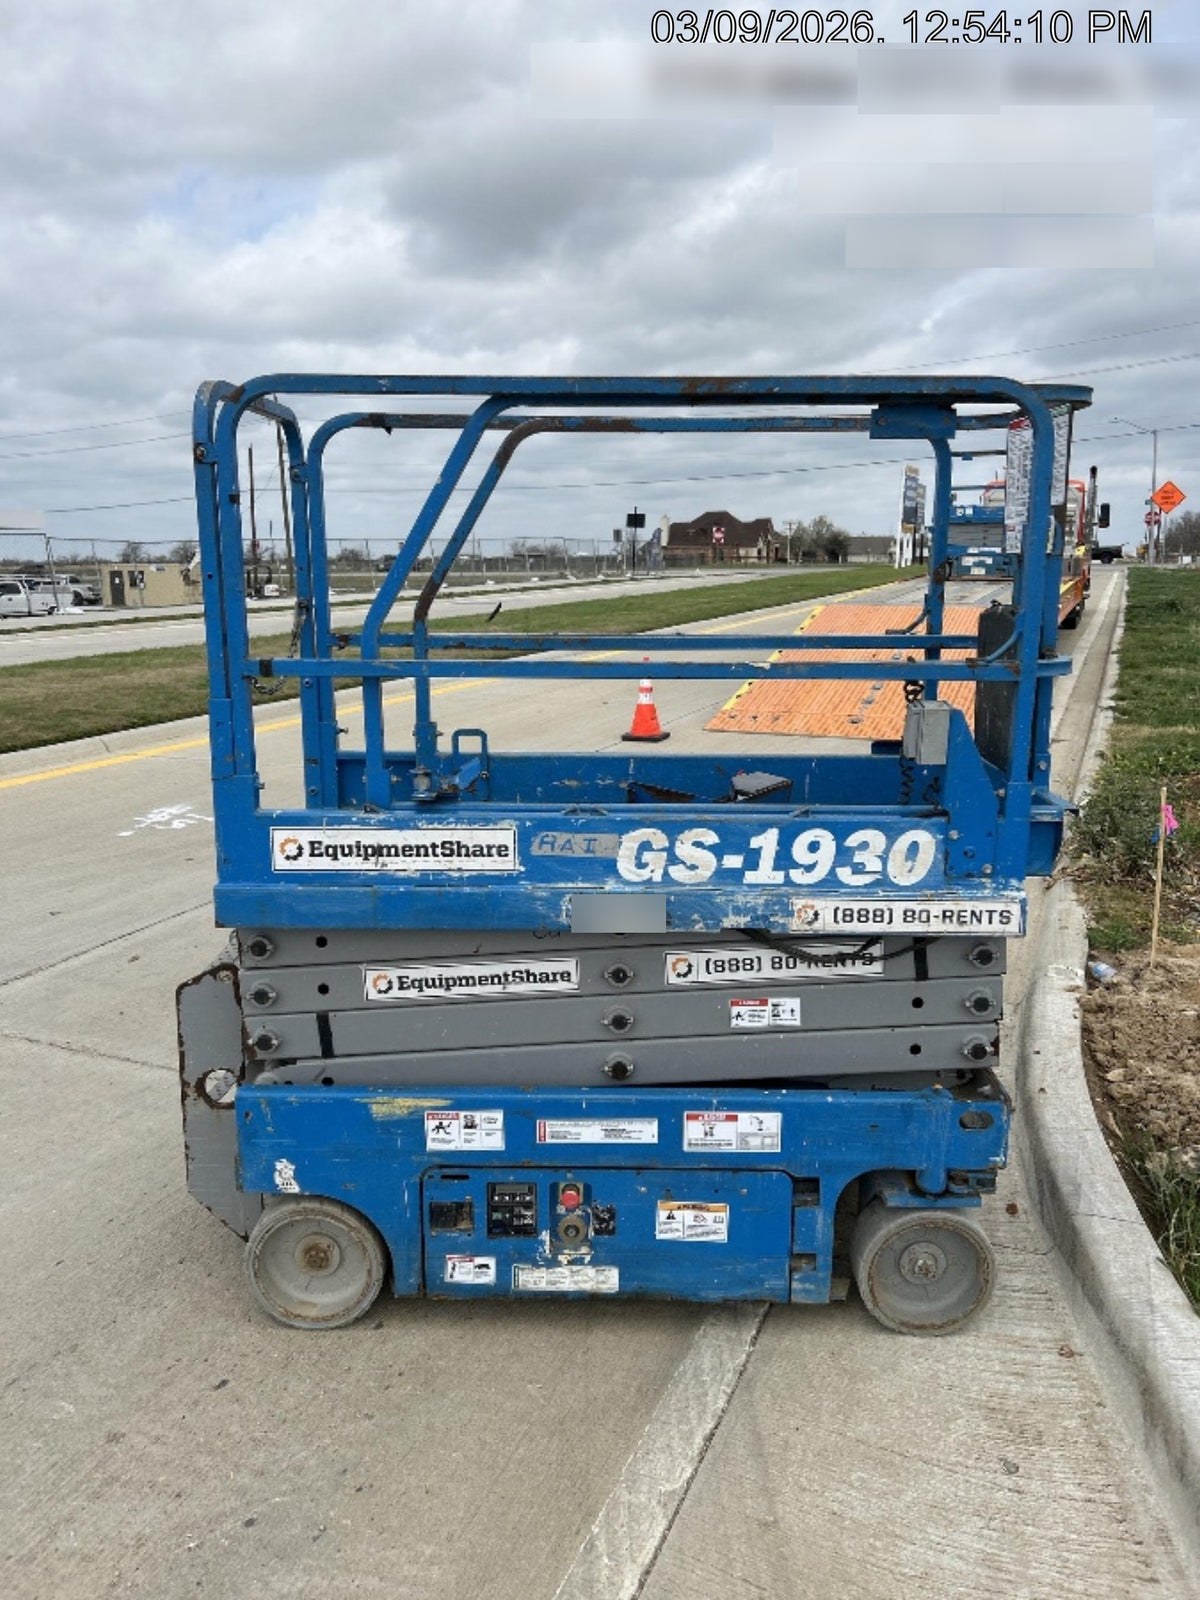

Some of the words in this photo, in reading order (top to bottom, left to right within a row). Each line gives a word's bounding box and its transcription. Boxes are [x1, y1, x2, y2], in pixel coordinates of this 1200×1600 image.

[308, 840, 510, 861] EquipmentShare
[616, 827, 937, 886] GS-1930
[833, 907, 893, 925] (888)
[903, 909, 1014, 926] 80-RENTS
[705, 956, 762, 975] (888)
[397, 969, 572, 991] EquipmentShare
